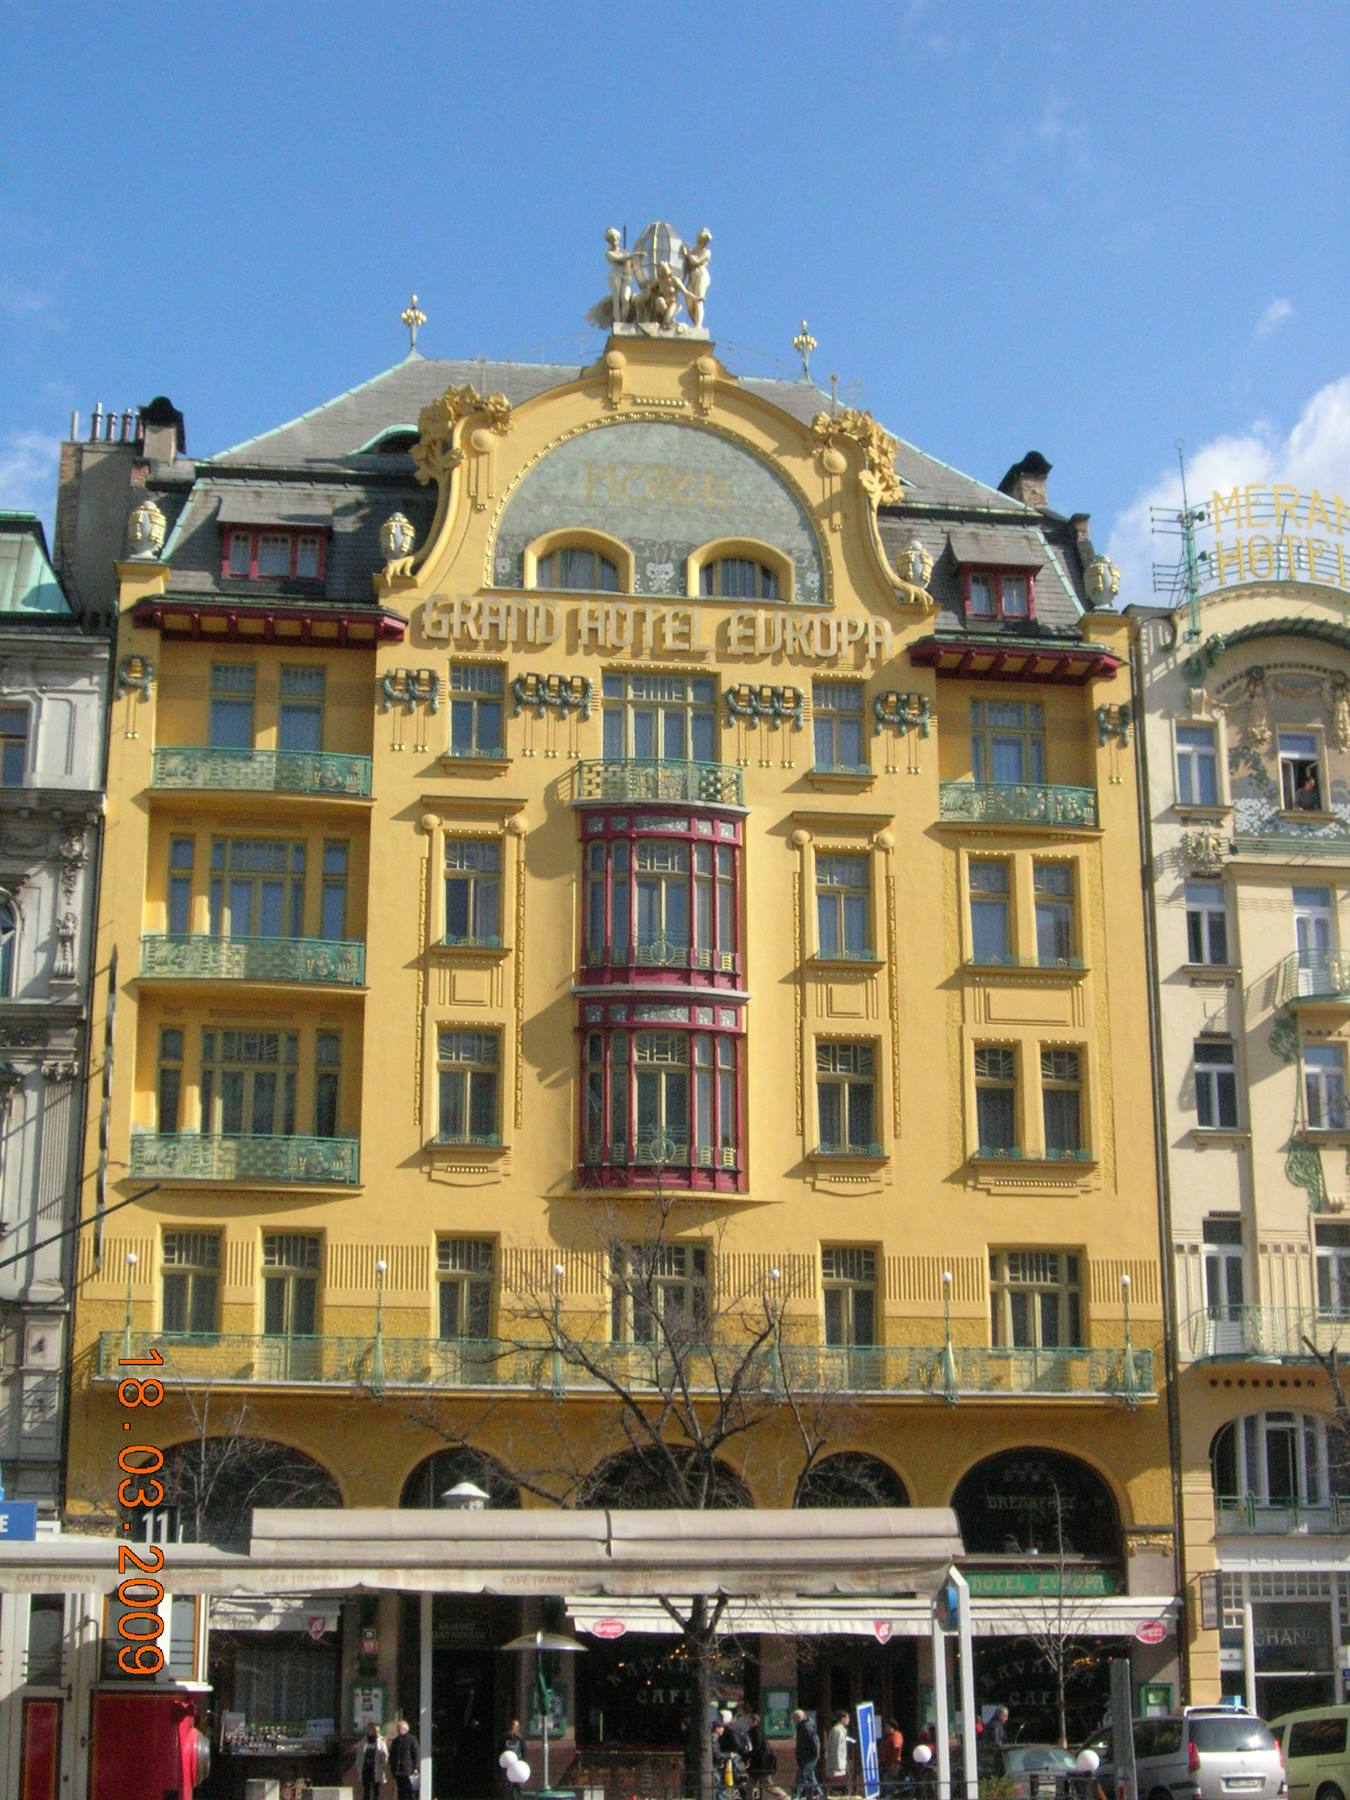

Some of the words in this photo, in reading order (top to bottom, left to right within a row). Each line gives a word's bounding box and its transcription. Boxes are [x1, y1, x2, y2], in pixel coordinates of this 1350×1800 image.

[1216, 534, 1350, 586] HOTEL
[424, 594, 563, 645] GRAND
[580, 600, 716, 652] HOTEL
